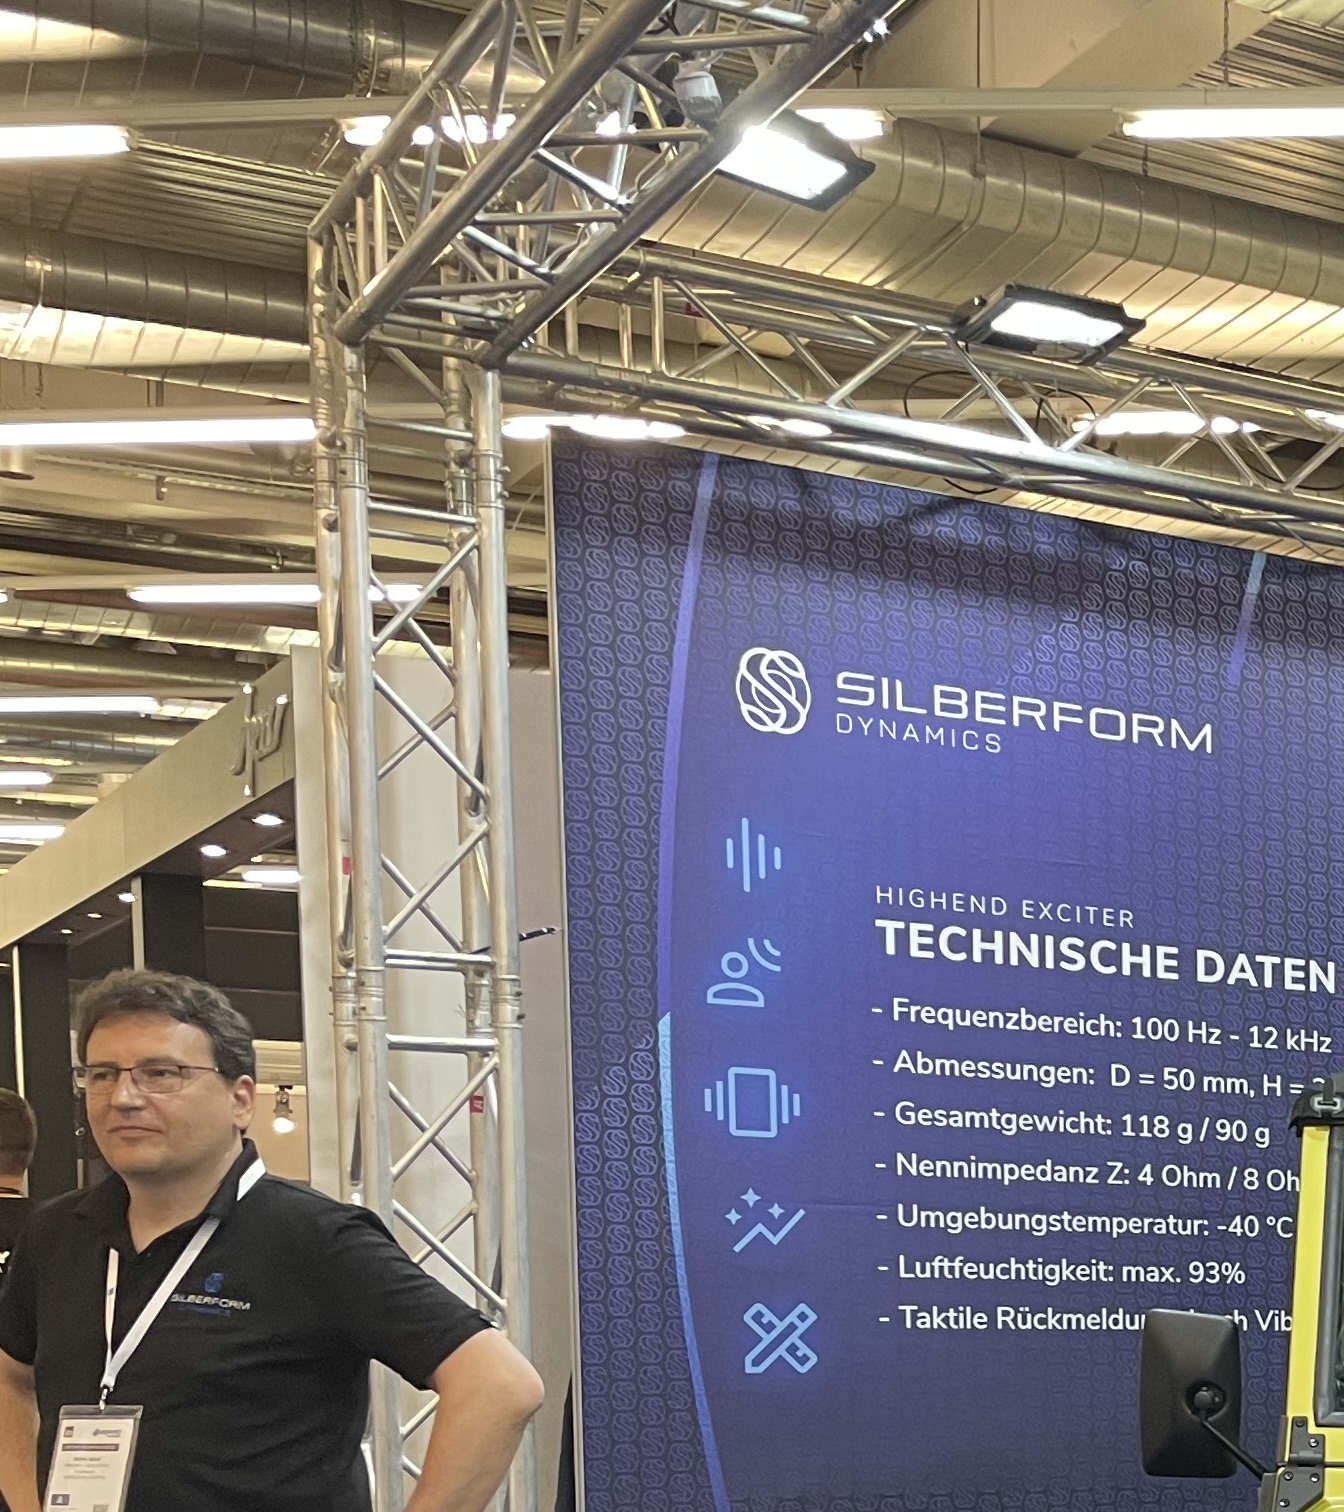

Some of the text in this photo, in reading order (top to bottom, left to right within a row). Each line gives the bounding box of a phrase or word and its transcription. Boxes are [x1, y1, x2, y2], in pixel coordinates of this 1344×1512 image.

[836, 670, 1212, 754] SILBERFORM
[836, 712, 1001, 754] DYNAMICS
[875, 884, 1135, 929] HIGHEND EXCITER
[875, 918, 1336, 995] TECHNISCHE DATEN
[892, 997, 1122, 1038] Frequenzbereich:
[1132, 1016, 1179, 1042] 100
[1188, 1022, 1221, 1045] Hz
[1250, 1026, 1278, 1050] 12
[1286, 1028, 1332, 1053] kHz
[893, 1049, 1095, 1086] Abmessungen:
[1110, 1063, 1131, 1087] D
[1164, 1067, 1195, 1091] 50
[1203, 1075, 1255, 1098] mm,
[1263, 1073, 1281, 1096] H
[895, 1101, 1112, 1138] Gesamtgewicht:
[1120, 1113, 1169, 1137] 118
[1177, 1121, 1193, 1144] g
[1198, 1116, 1209, 1142] /
[1215, 1118, 1247, 1143] 90
[1254, 1124, 1270, 1148] g
[896, 1152, 1099, 1187] Nennimpedanz
[1106, 1161, 1131, 1185] Z:
[1137, 1162, 1154, 1186] 4
[1161, 1164, 1221, 1189] Ohm
[1226, 1166, 1238, 1191] /
[1243, 1167, 1259, 1191] 8
[1266, 1168, 1300, 1192] Oh
[897, 1203, 1208, 1238] Umgebungstemperatur:
[1216, 1215, 1259, 1238] -40
[1265, 1216, 1294, 1239] °C
[899, 1254, 1115, 1286] Luftfeuchtigkeit:
[1122, 1264, 1182, 1284] max.
[1188, 1260, 1246, 1284] 93%
[899, 1305, 988, 1331] Taktile
[996, 1305, 1147, 1331] Rückmeldu
[1254, 1308, 1293, 1332] Vib
